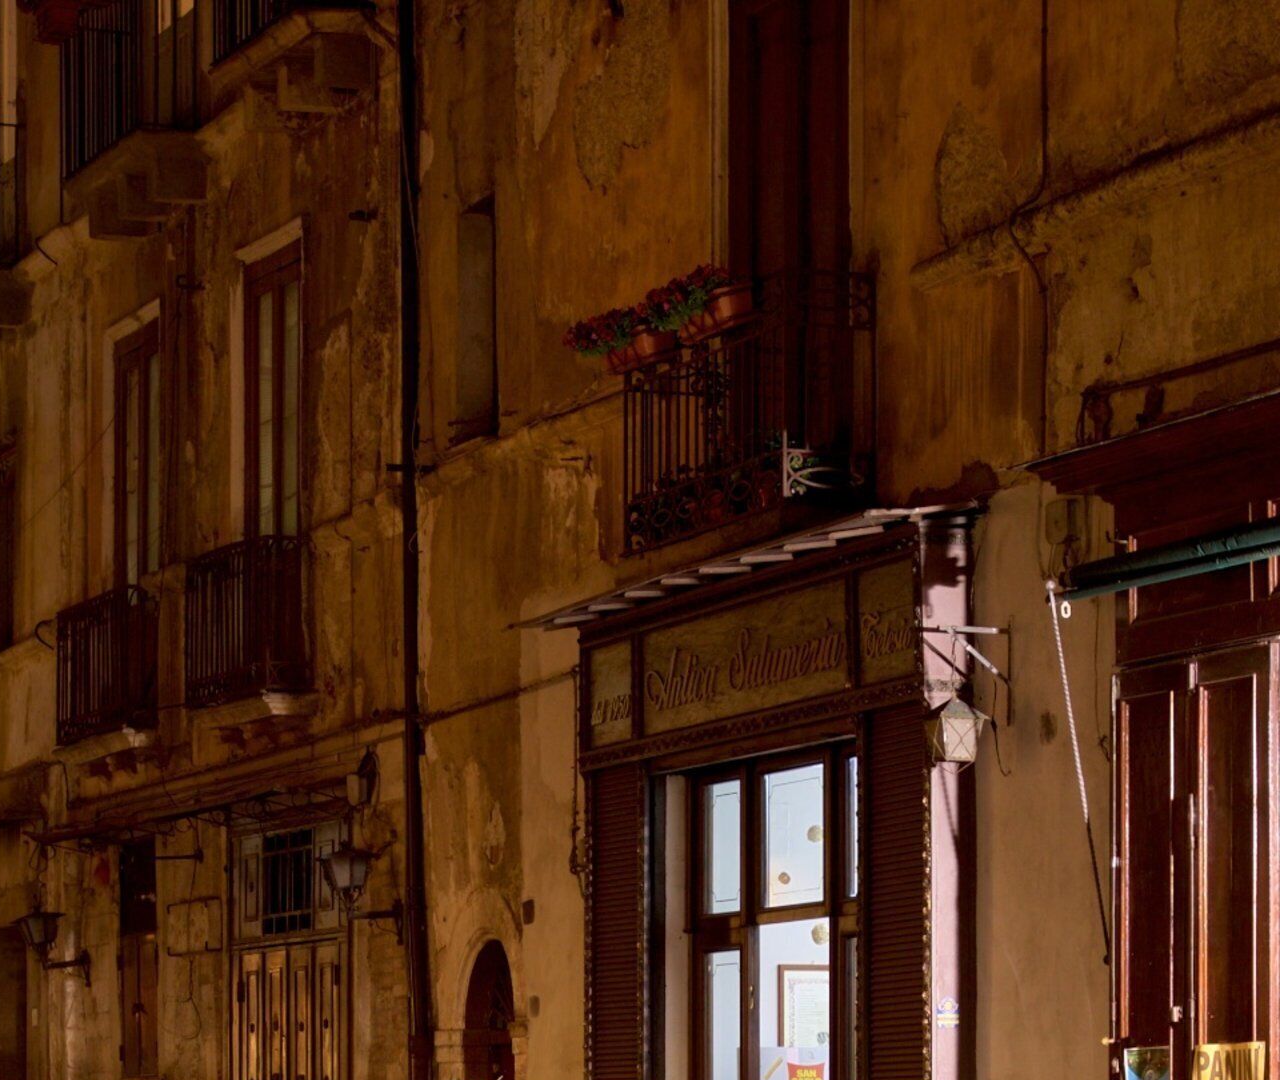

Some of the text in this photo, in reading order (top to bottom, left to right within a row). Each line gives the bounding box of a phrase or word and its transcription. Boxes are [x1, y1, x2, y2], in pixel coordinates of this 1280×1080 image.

[646, 645, 720, 712] Antica
[728, 617, 847, 692] Salumeria
[796, 1069, 816, 1078] SAN
